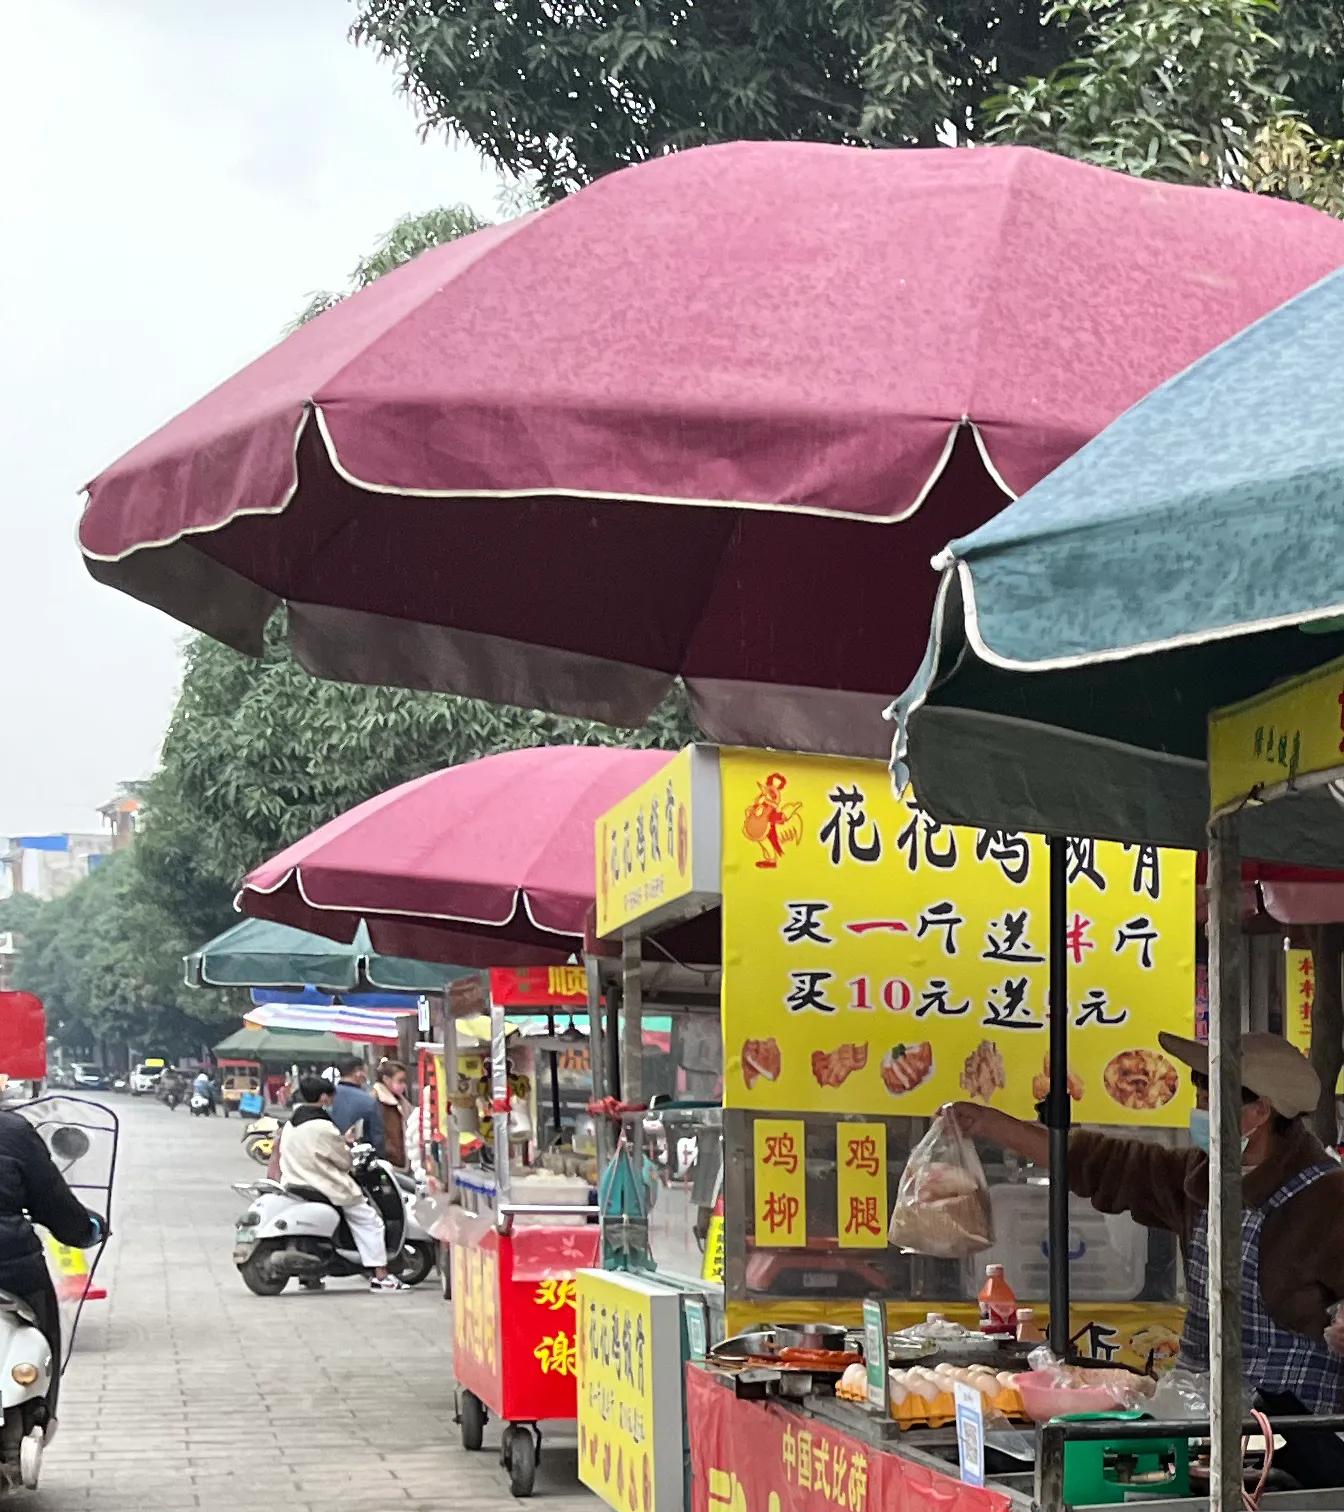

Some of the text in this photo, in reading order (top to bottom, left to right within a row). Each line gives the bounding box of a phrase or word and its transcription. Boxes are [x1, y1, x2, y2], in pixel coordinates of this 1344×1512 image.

[783, 902, 1158, 967] 买一斤送半斤
[786, 972, 1127, 1028] 买10元送元
[762, 1132, 799, 1235] 鸡柳
[845, 1135, 881, 1236] 鸡腿
